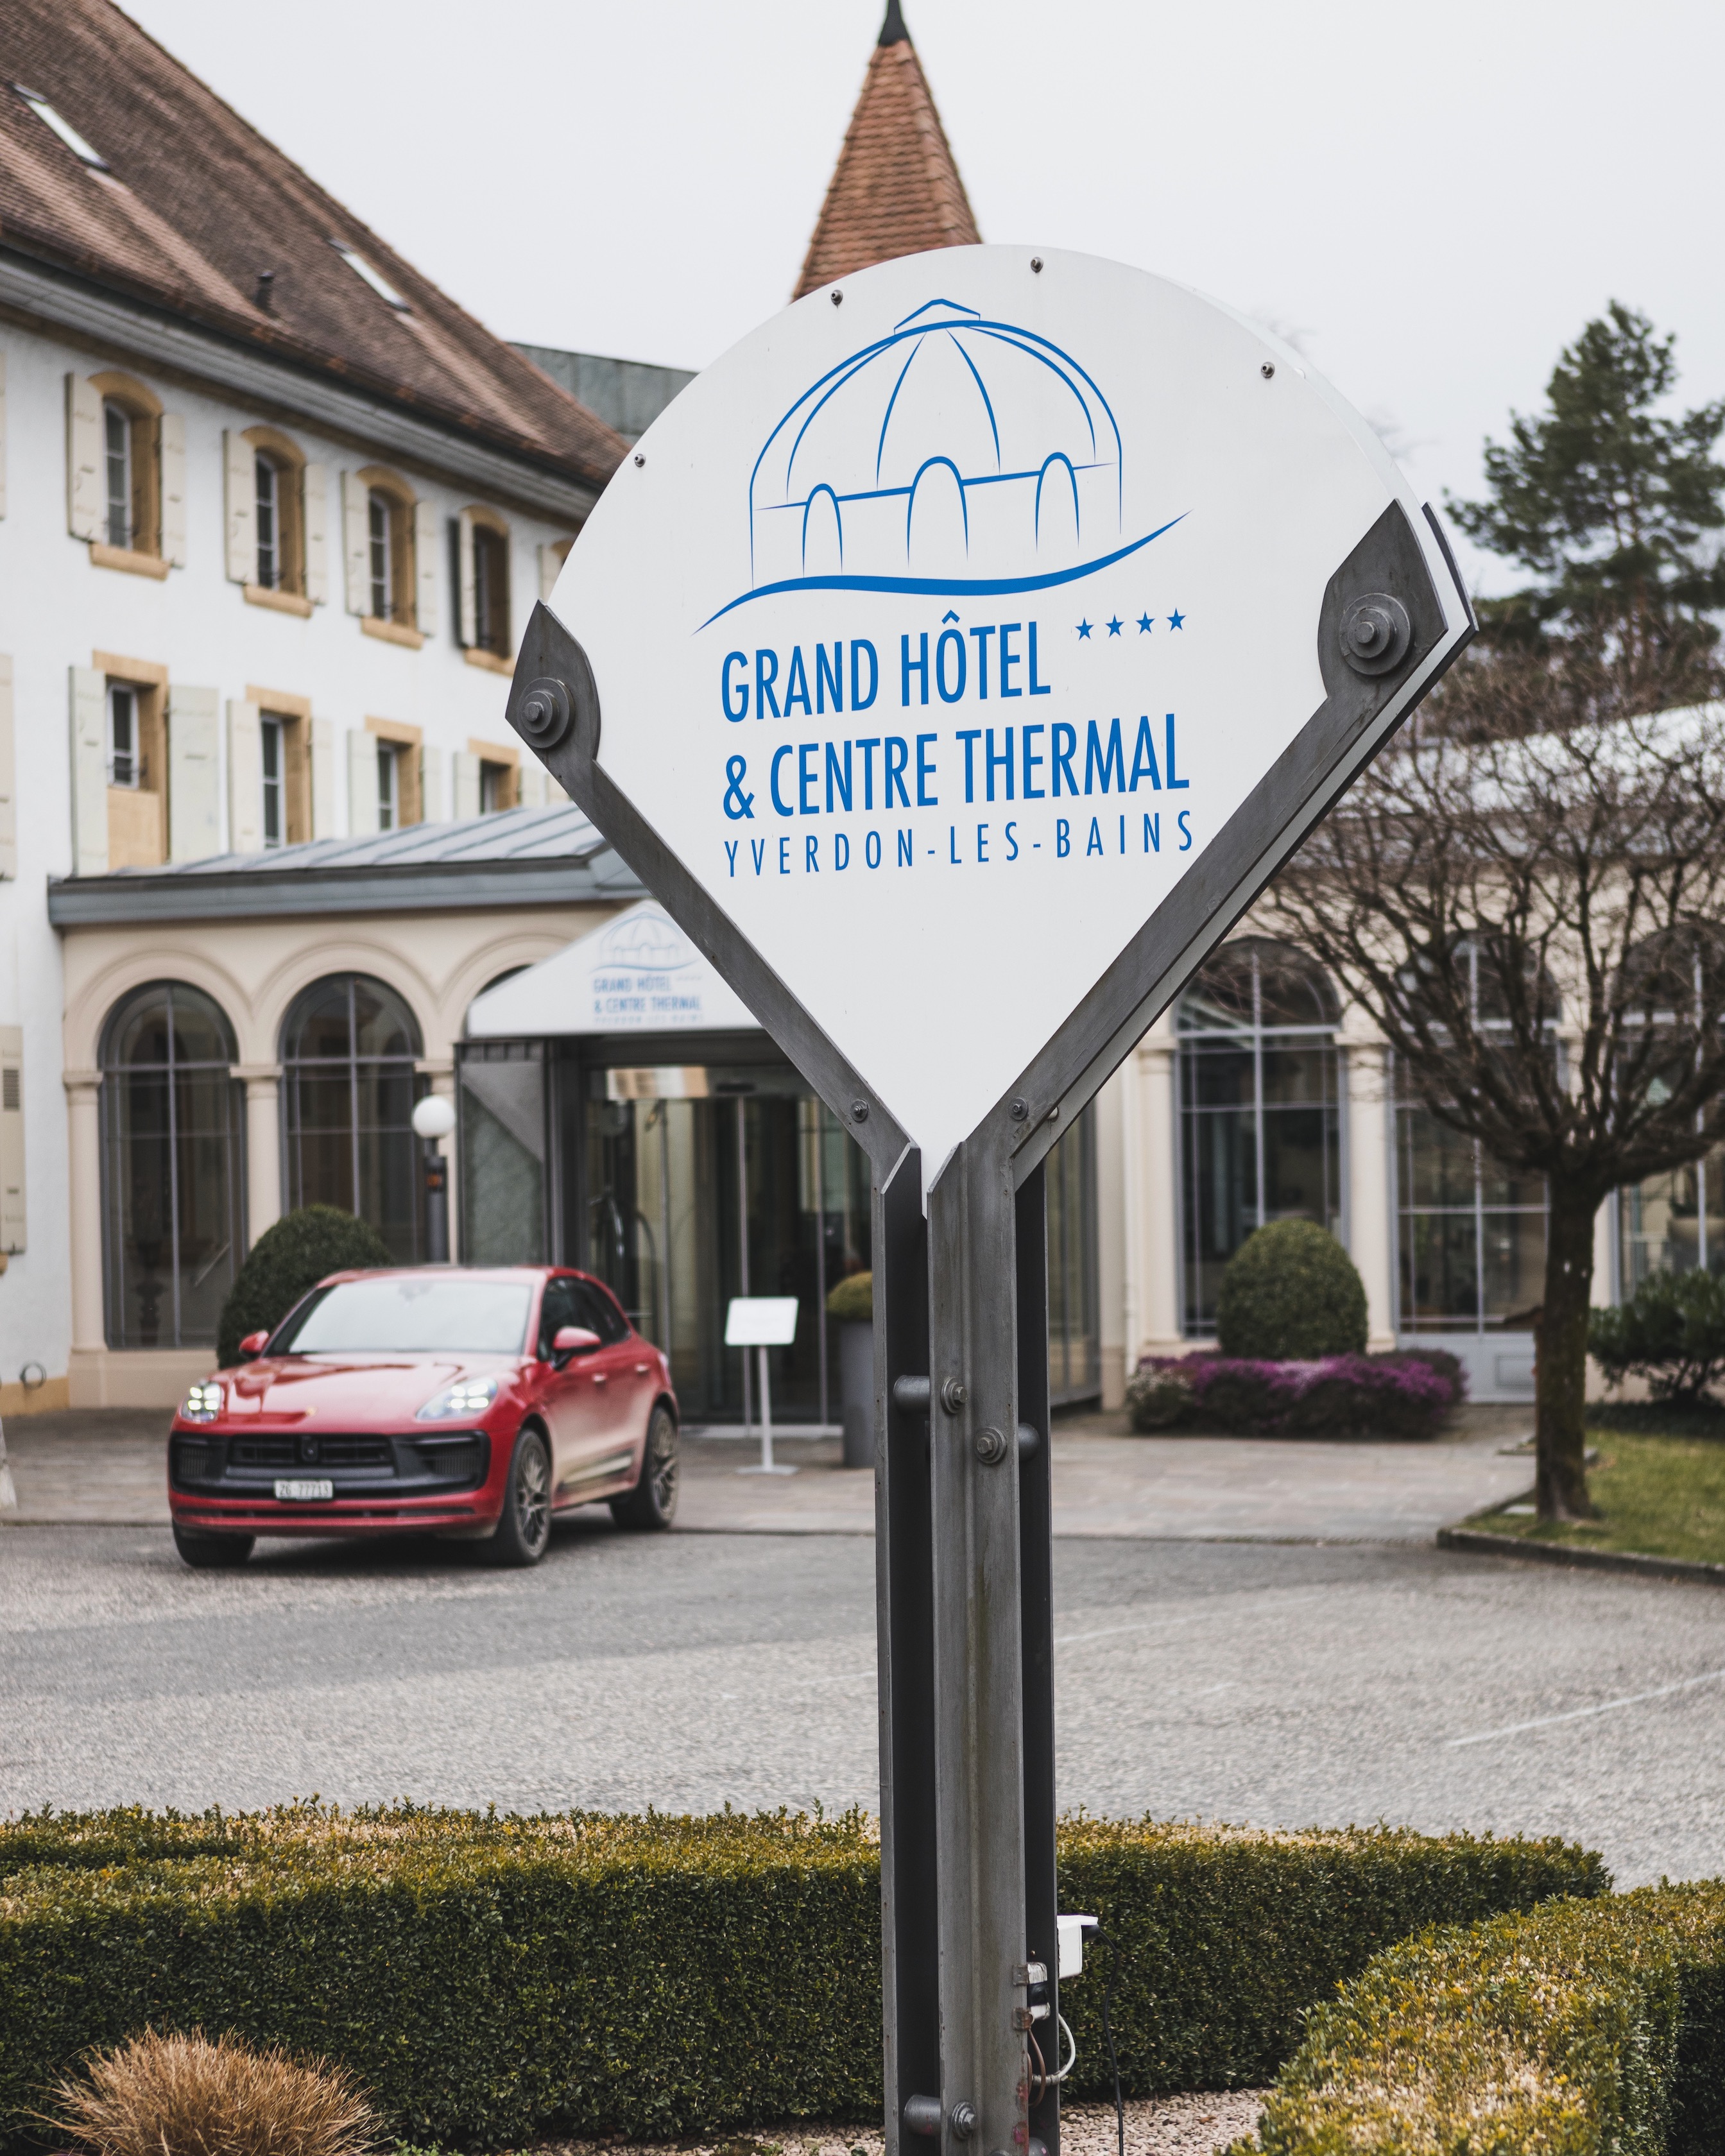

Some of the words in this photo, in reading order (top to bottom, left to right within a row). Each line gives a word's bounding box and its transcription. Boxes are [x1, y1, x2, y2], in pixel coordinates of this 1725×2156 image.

[721, 638, 879, 723] GRAND
[900, 610, 1051, 707] HÔTEL
[723, 754, 755, 821] &
[770, 733, 939, 817] CENTRE
[955, 713, 1190, 803] THERMAL
[724, 810, 1192, 877] YVERDON-LES-BAINS
[594, 977, 631, 993] GRAND
[606, 997, 646, 1013] CENTRE
[651, 995, 702, 1011] THERMAL
